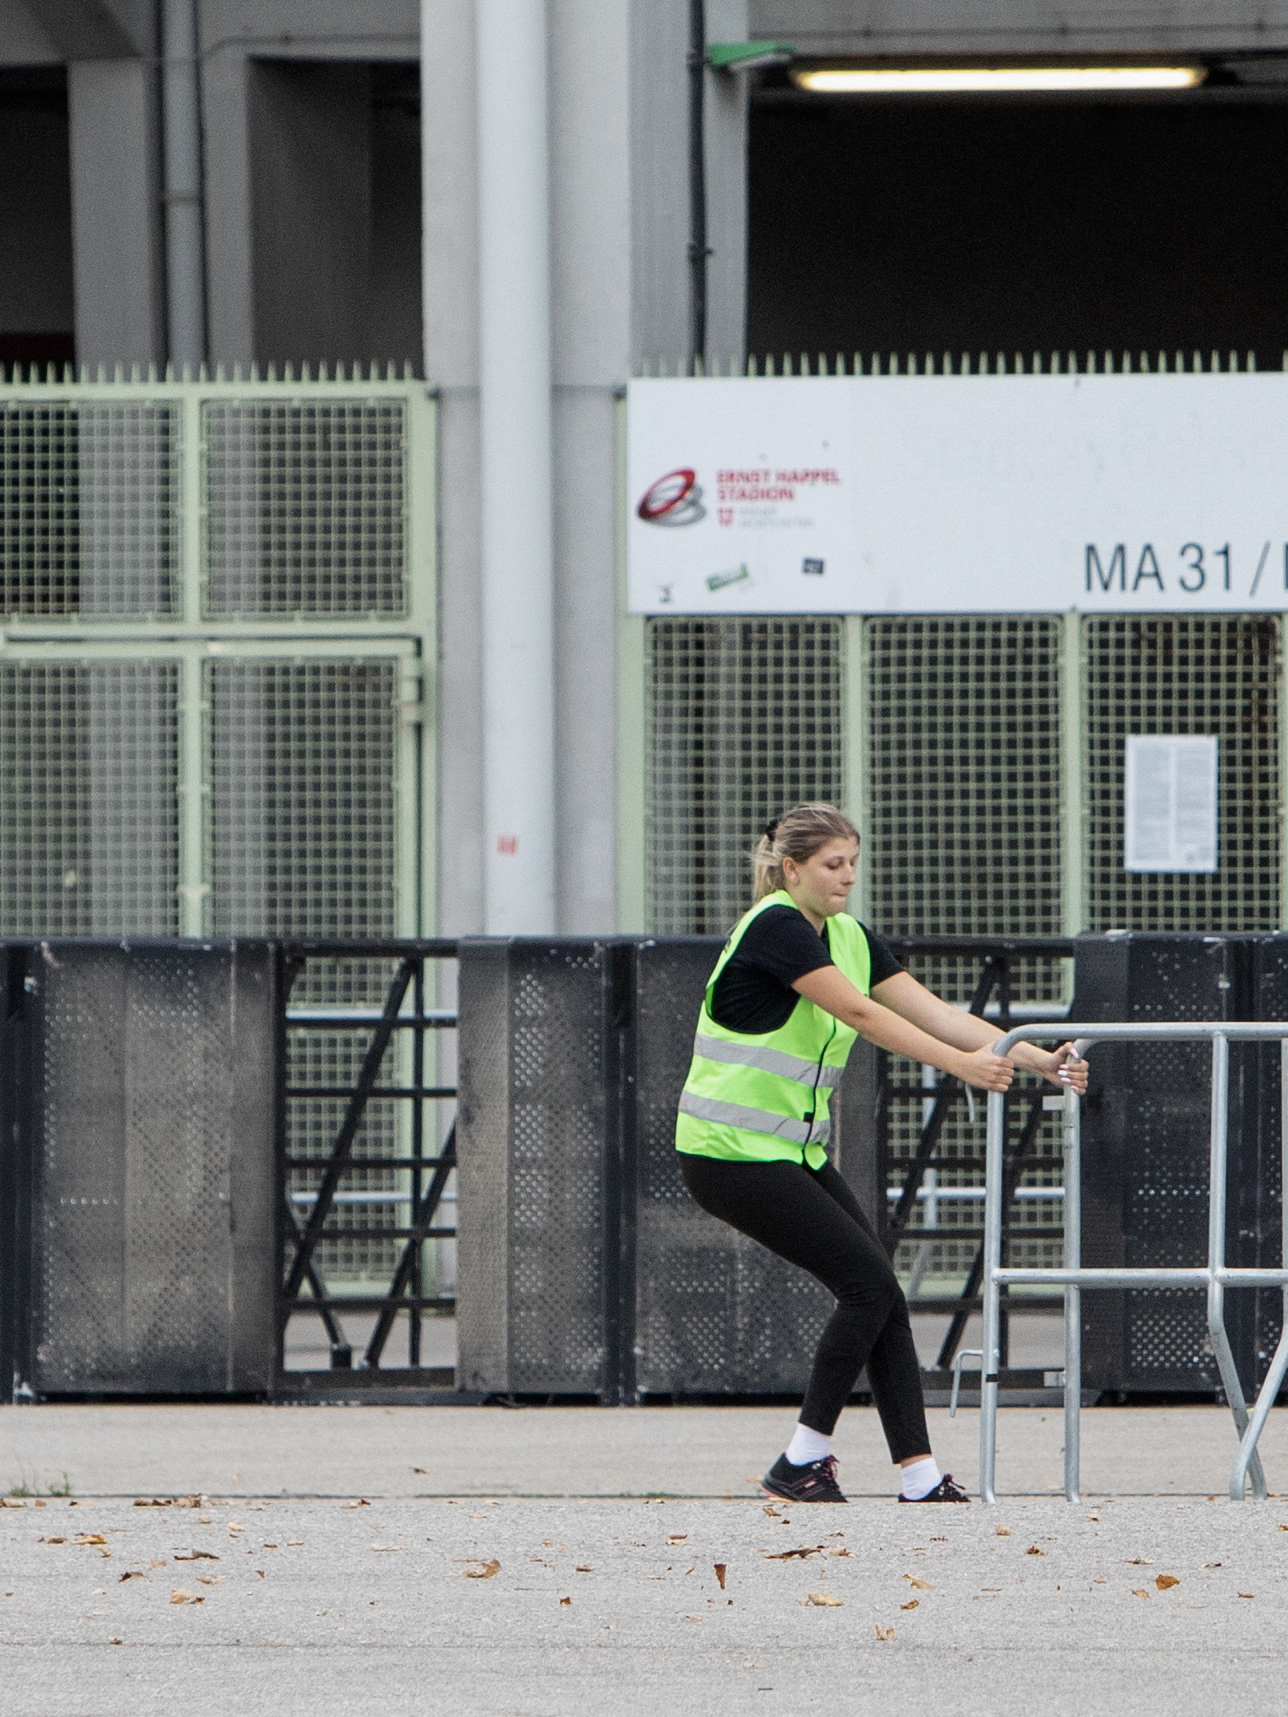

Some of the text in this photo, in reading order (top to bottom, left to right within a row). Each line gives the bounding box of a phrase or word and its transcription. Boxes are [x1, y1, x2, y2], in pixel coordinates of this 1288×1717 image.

[717, 468, 840, 484] ERNST HAPPEL
[717, 486, 795, 501] STADION
[1085, 543, 1165, 592] MA
[1179, 543, 1230, 592] 31
